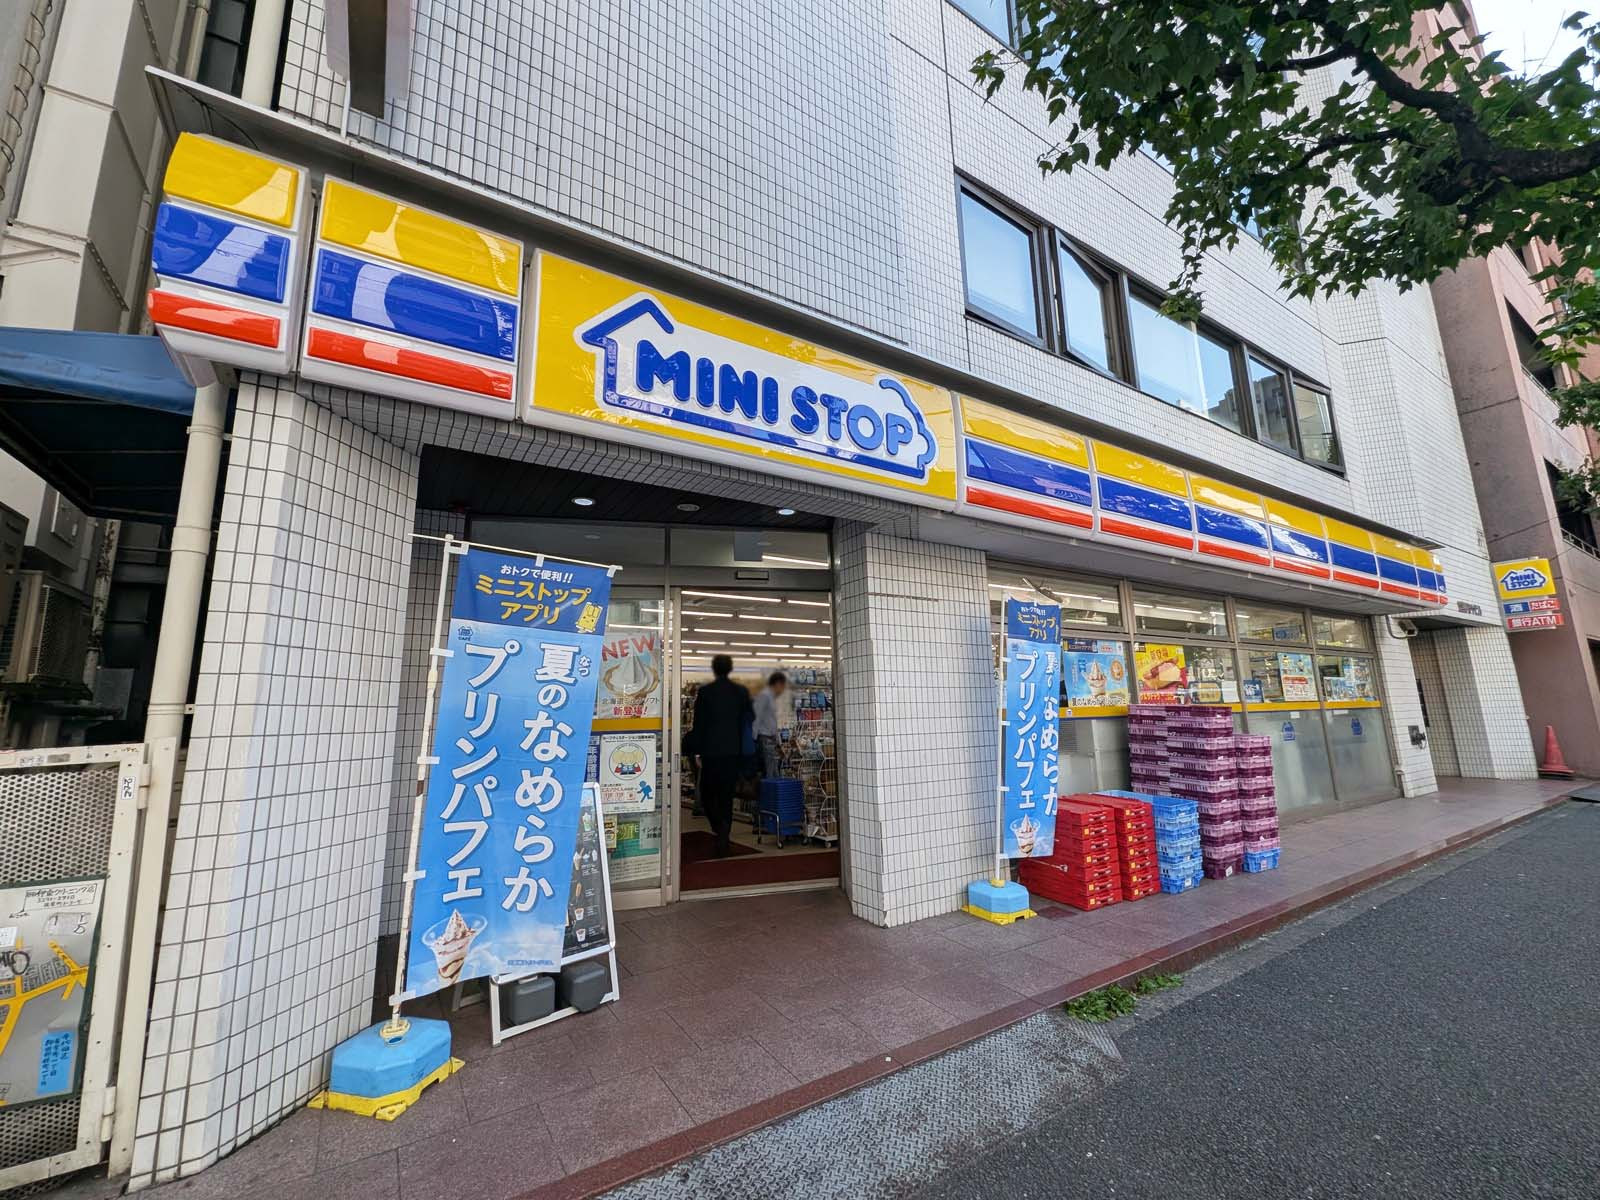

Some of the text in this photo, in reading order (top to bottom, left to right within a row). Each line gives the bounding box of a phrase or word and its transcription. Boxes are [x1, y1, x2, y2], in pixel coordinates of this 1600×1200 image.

[635, 339, 913, 455] MINI STOP
[1510, 573, 1535, 581] MINI
[1510, 580, 1537, 588] STOP
[476, 574, 592, 606] ミニストップ
[501, 602, 560, 624] アプリ
[1531, 600, 1555, 610] たばこ
[1511, 615, 1557, 628] 銀行ATM
[578, 655, 592, 677] なつ
[1014, 650, 1039, 809] プリンパフェ
[439, 639, 521, 903] プリンパフェ
[501, 642, 581, 913] 夏のなめらか
